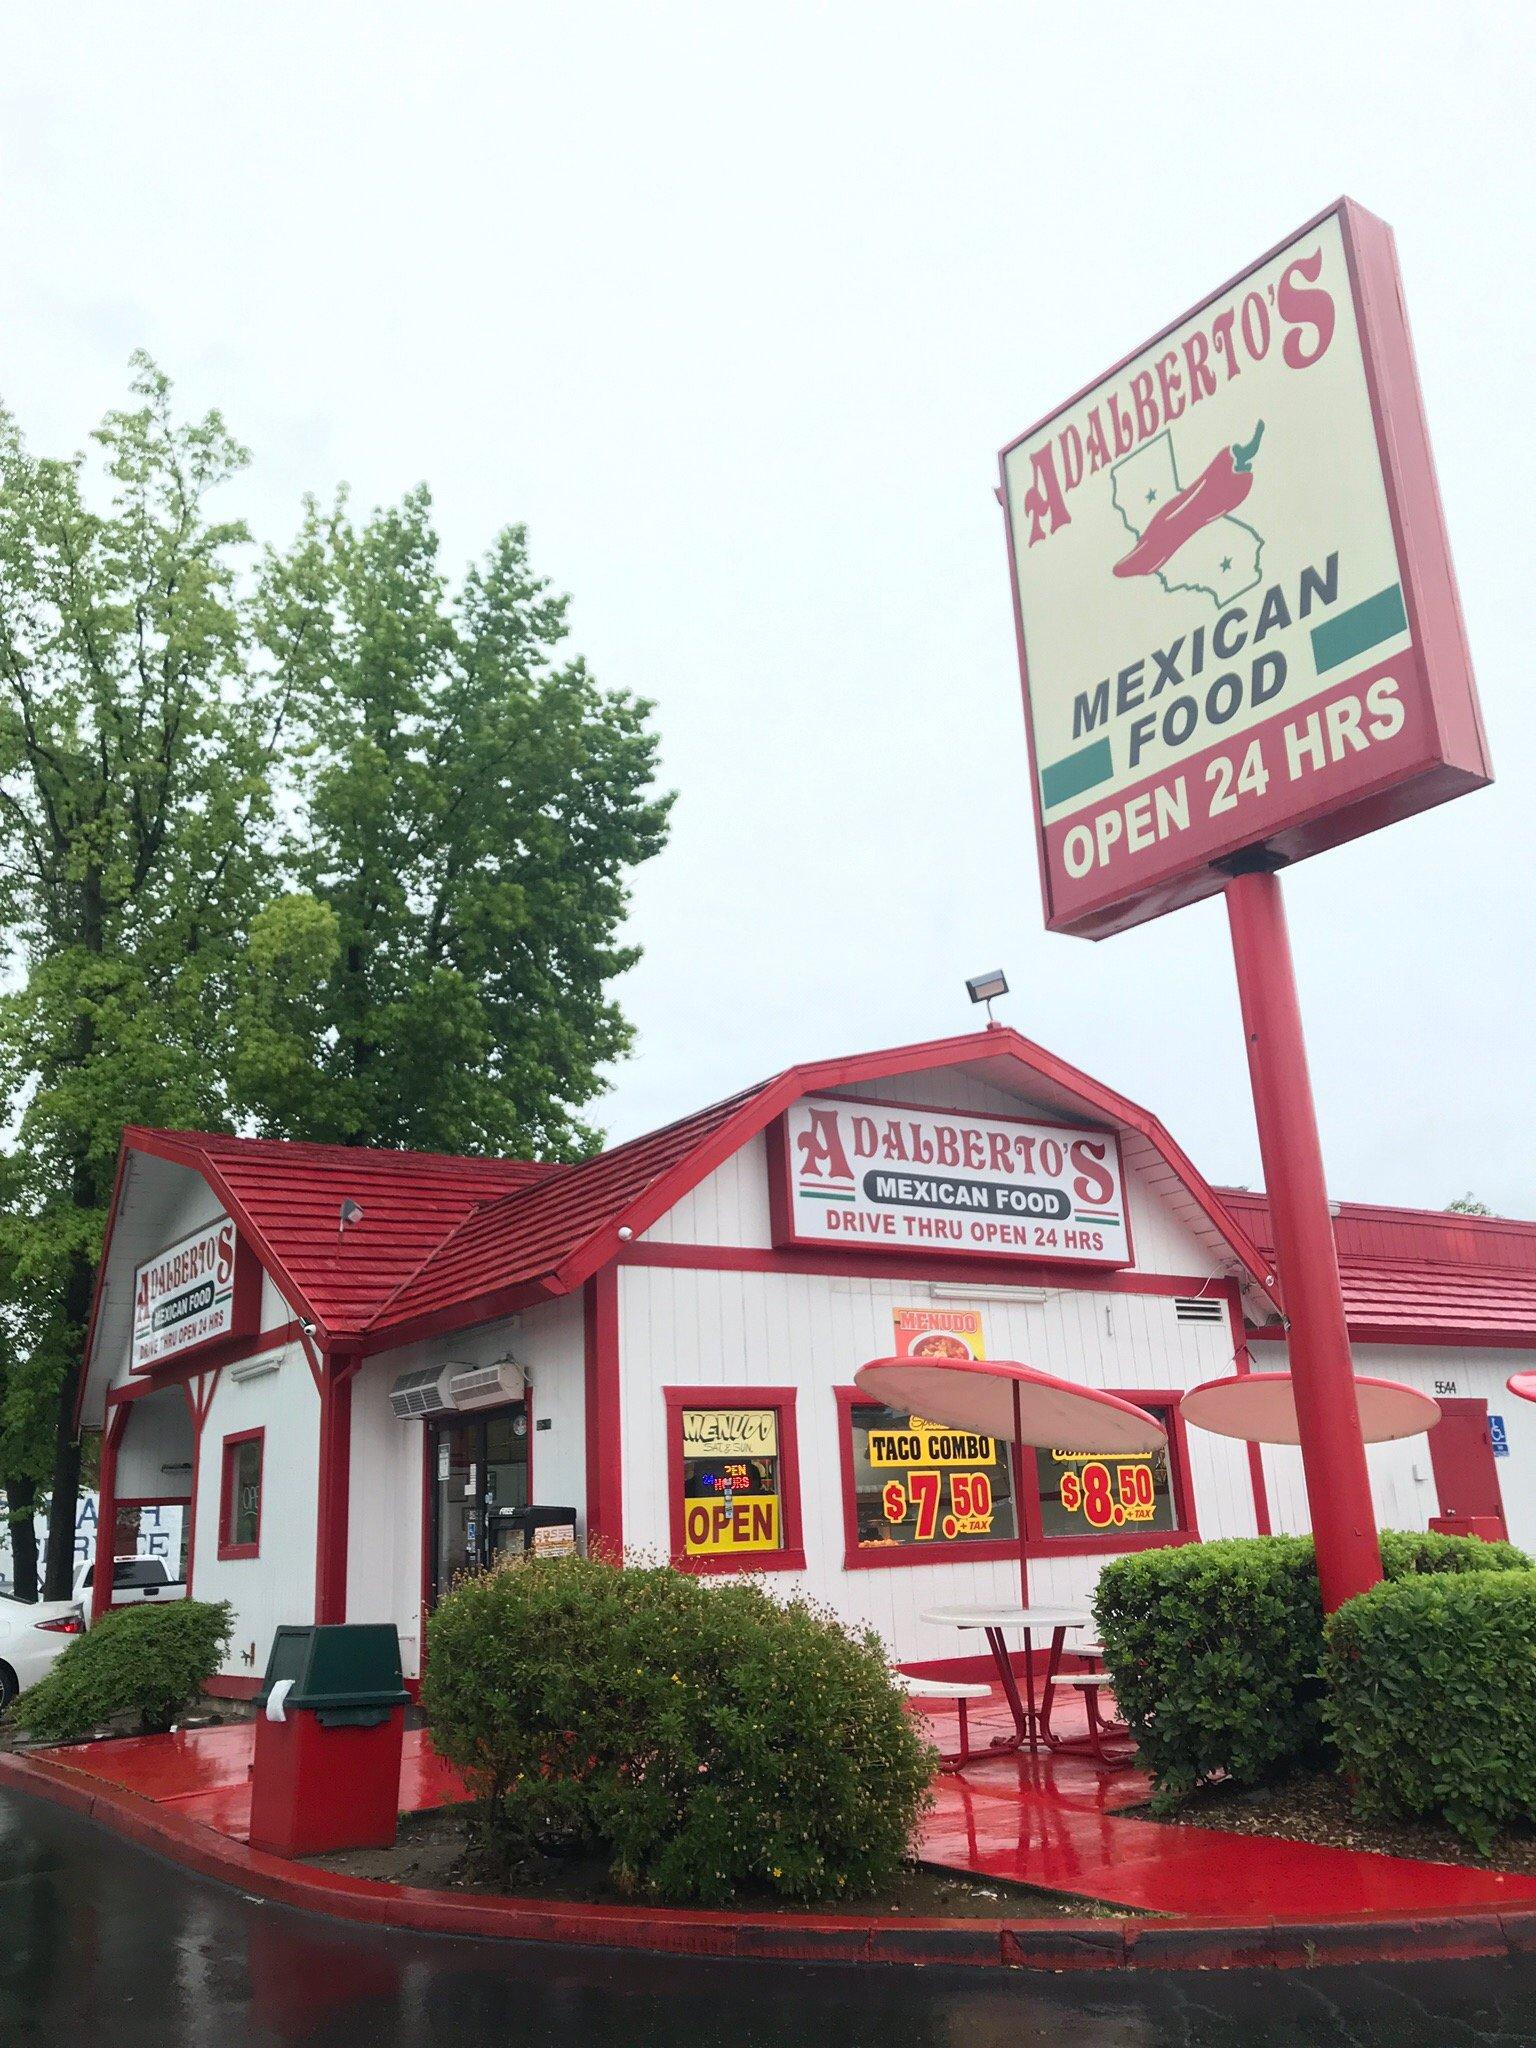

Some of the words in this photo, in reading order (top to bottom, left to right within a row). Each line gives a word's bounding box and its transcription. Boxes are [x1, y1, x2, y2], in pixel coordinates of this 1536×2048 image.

[1024, 245, 1336, 549] ADALBERTO'S
[1072, 551, 1339, 741] MEXICAN
[1129, 650, 1288, 770] FOOD
[1063, 775, 1191, 879] OPEN
[1205, 739, 1270, 819] 24
[1283, 676, 1406, 782] HRS
[797, 1106, 1115, 1205] ADALBERTO'S
[876, 1176, 989, 1208] MEXICAN
[996, 1189, 1060, 1215] FOOD
[826, 1209, 897, 1235] DRIVE
[902, 1215, 964, 1240] THRU
[970, 1221, 1027, 1246] OPEN
[1033, 1226, 1058, 1248] 24
[1064, 1229, 1105, 1252] HRS
[136, 1225, 233, 1324] ADALBERTO'S
[153, 1297, 189, 1328] MEXICAN
[187, 1286, 212, 1314] FOOD
[178, 1322, 198, 1345] OPEN
[198, 1320, 208, 1336] 24
[208, 1309, 225, 1332] HRS
[900, 1310, 977, 1333] MENUDO
[683, 1414, 773, 1442] MENUDO
[703, 1442, 723, 1453] SAT
[872, 1435, 922, 1461] TACO
[928, 1435, 990, 1460] COMBO
[885, 1474, 990, 1537] $7.50
[1062, 1465, 1153, 1524] $8.50
[1135, 1509, 1152, 1518] TAX
[688, 1503, 773, 1546] OPEN
[969, 1520, 989, 1530] TAX
